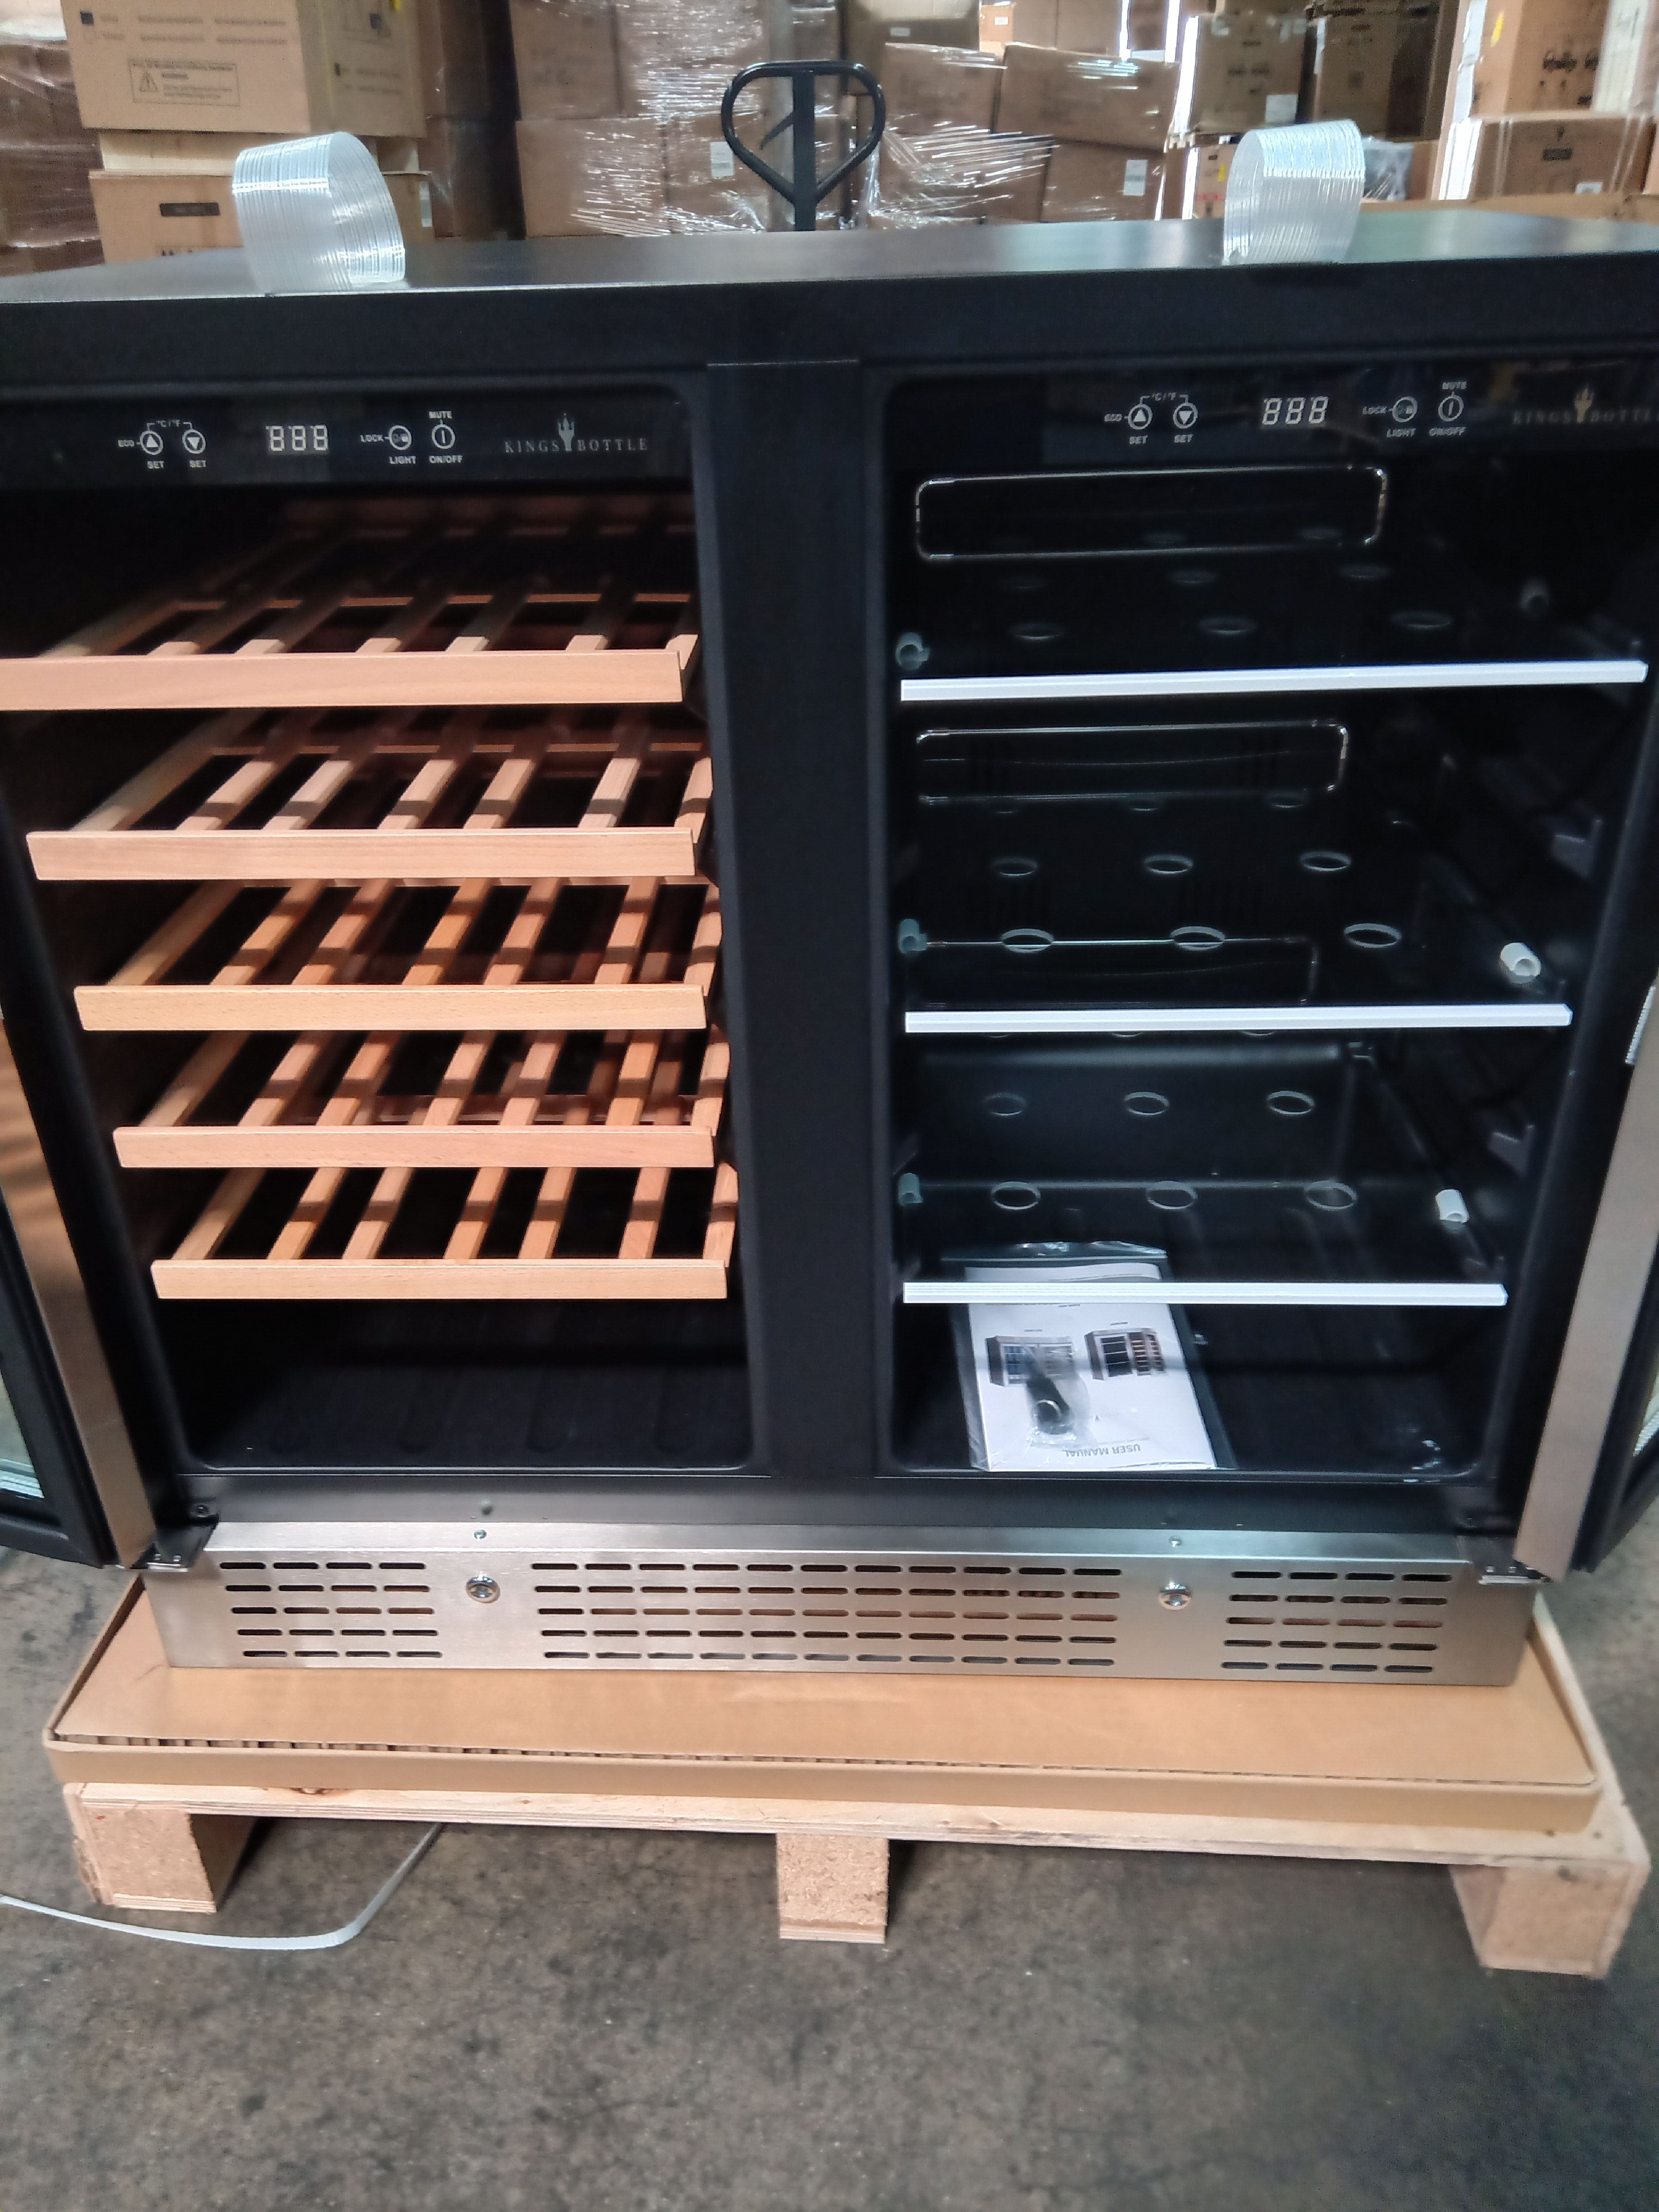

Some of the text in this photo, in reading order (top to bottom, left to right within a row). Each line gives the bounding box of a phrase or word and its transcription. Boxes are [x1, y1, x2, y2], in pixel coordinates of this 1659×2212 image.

[360, 434, 384, 442] LOCK
[504, 438, 648, 453] KINGS BOTTLE
[189, 460, 206, 468] SET
[389, 456, 416, 465] LIGHT
[429, 455, 463, 464] ON/OFF
[147, 461, 164, 469] SET
[1062, 1444, 1141, 1457] USER MANUAL
